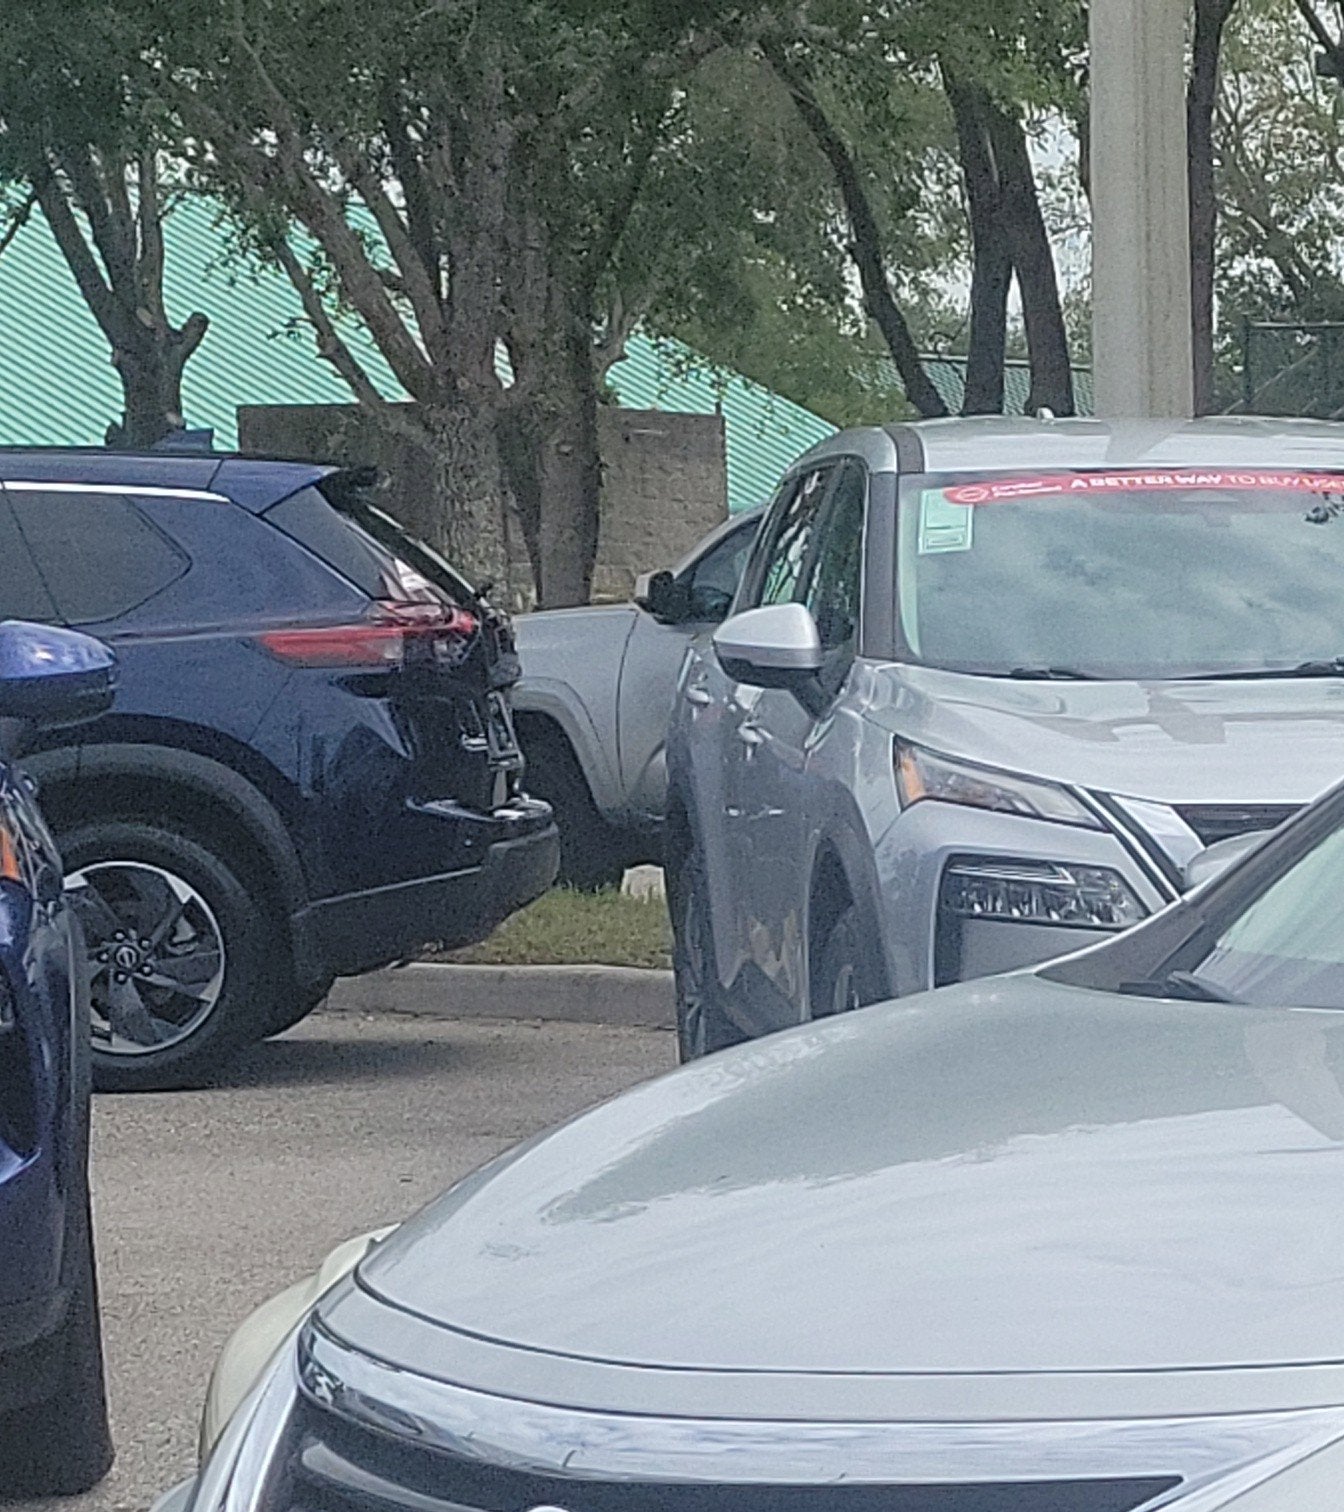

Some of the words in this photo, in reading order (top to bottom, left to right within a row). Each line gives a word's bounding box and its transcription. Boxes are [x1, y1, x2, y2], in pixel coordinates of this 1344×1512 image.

[1071, 478, 1088, 489] A
[1089, 475, 1174, 487] BETTER
[1174, 474, 1222, 485] WAY
[1225, 474, 1256, 485] TO
